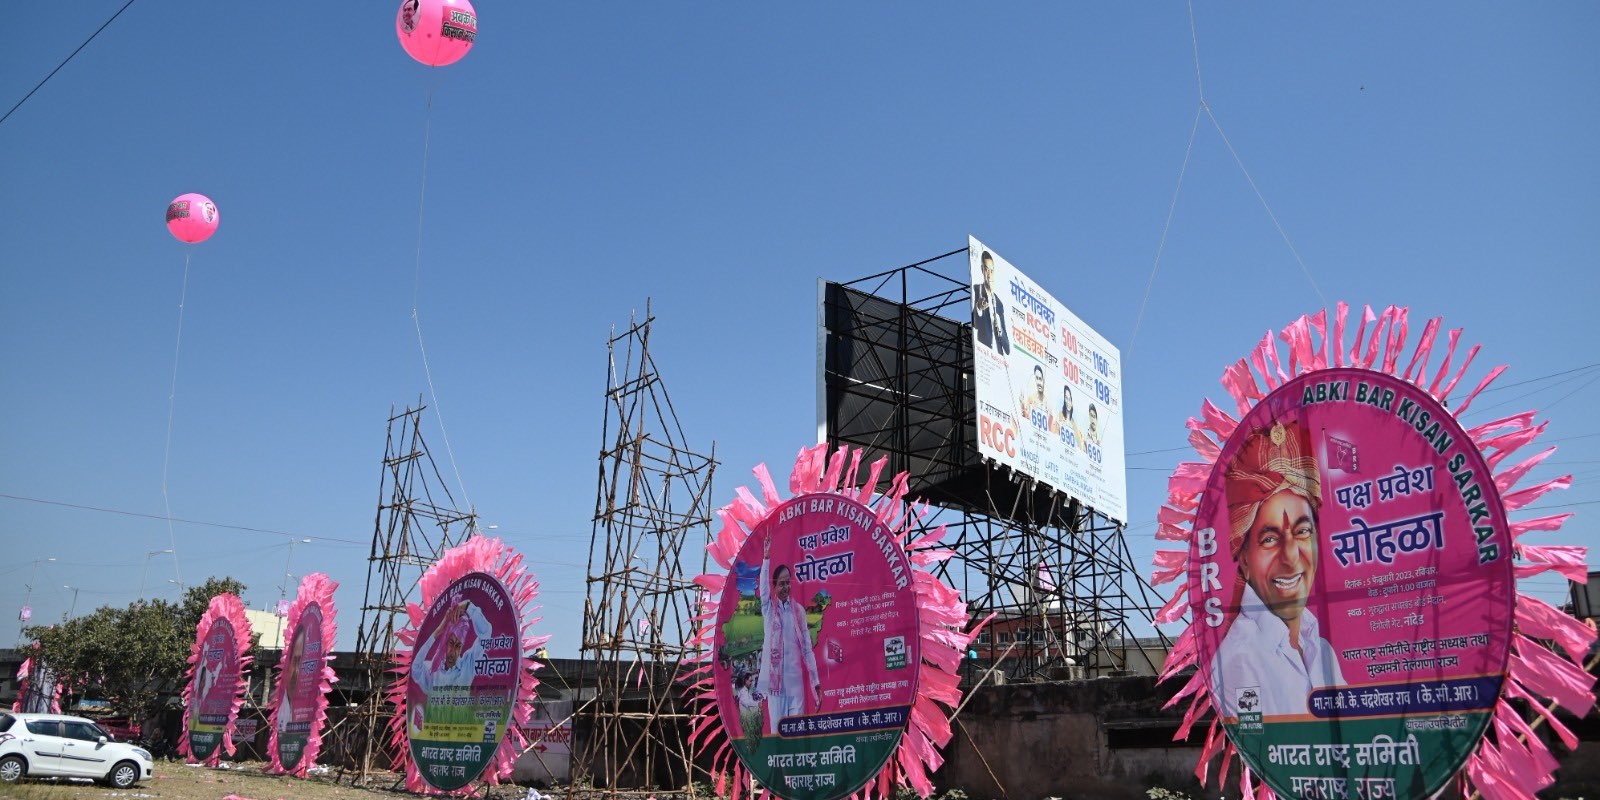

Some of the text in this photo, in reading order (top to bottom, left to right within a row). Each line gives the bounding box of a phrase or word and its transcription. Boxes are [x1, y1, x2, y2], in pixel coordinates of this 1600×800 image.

[1026, 312, 1050, 338] RCC
[1062, 326, 1078, 354] 500
[1063, 357, 1078, 384] 600
[1094, 378, 1110, 405] 198
[1032, 408, 1048, 432] 690
[980, 414, 1016, 458] RCC
[1061, 425, 1075, 448] 690
[1087, 443, 1102, 464] 690
[1302, 382, 1499, 564] ABKI BAR KISAN SARKAR
[1336, 465, 1434, 509] पक्ष प्रवेश
[779, 500, 908, 591] ABKI BAR KISAN SARKAR
[798, 526, 850, 550] पक्ष प्रवेश
[1331, 512, 1444, 567] सोहळा
[794, 552, 854, 582] सोहळा
[464, 579, 482, 589] KISAN
[482, 581, 504, 611] SARKAR
[480, 634, 514, 650] पक्ष प्रवेश
[1342, 634, 1490, 662] भारत राष्ट्र समितीचे राष्ट्रीय अध्यक्ष तथा
[474, 654, 512, 676] सोहळा
[1366, 655, 1458, 678] मुख्यमंत्री तेलंगणा राज्य
[1360, 688, 1394, 708] चंद्रशेखर
[1396, 691, 1410, 705] राव
[818, 716, 842, 730] चंद्रशेखर
[843, 717, 854, 726] राव
[422, 744, 481, 762] भारत राष्ट्र समिति
[768, 744, 856, 768] भारत राष्ट्र समिति
[1268, 734, 1421, 768] भारत राष्ट्र समिती
[452, 766, 466, 778] राज्य
[784, 773, 836, 791] महाराष्ट्र राज्य
[1354, 778, 1396, 800] राज्य
